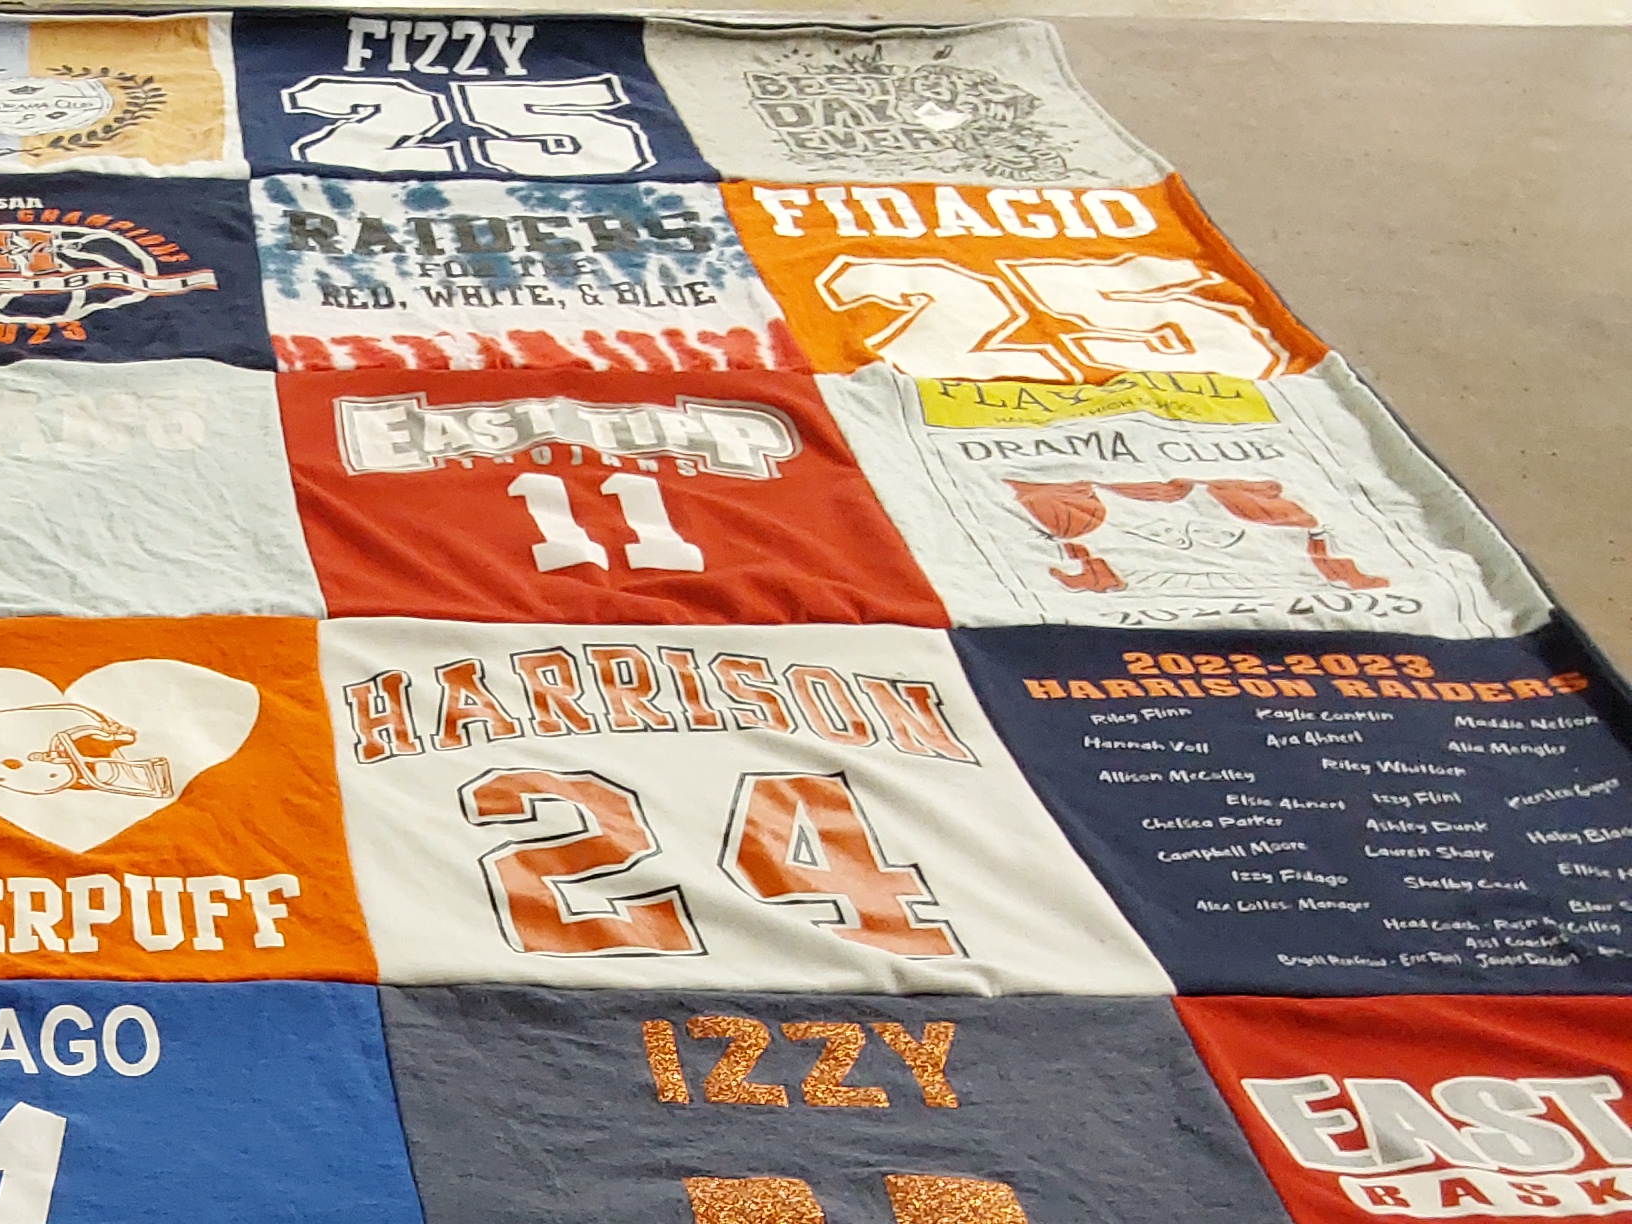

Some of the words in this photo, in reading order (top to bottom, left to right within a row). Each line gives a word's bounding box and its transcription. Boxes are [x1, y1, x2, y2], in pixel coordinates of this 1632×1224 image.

[342, 17, 534, 75] FIZZY
[746, 72, 898, 98] BEST
[280, 72, 657, 173] 25
[752, 100, 902, 129] DAY
[781, 127, 953, 152] EVER
[16, 208, 190, 263] CHAMPIONS
[282, 208, 717, 256] RAIDERS
[320, 280, 408, 311] RED,
[421, 282, 566, 311] WHITE,
[579, 282, 603, 305] &
[613, 280, 717, 308] BLUE
[814, 253, 1290, 385] 25
[348, 398, 564, 468] EAST
[576, 400, 788, 472] TIPP
[958, 431, 1145, 463] DRAMA
[1158, 440, 1283, 463] CLUB
[507, 472, 704, 573] 11
[1022, 676, 1318, 702] HARRISON
[1333, 670, 1591, 702] RAIDERS
[1120, 652, 1436, 679] 2022-2023
[343, 643, 982, 768] HARRISON
[1083, 735, 1166, 750] Hannah
[457, 766, 971, 961] 24
[640, 1014, 960, 1109] IZZY
[1240, 1073, 1632, 1174] EAST
